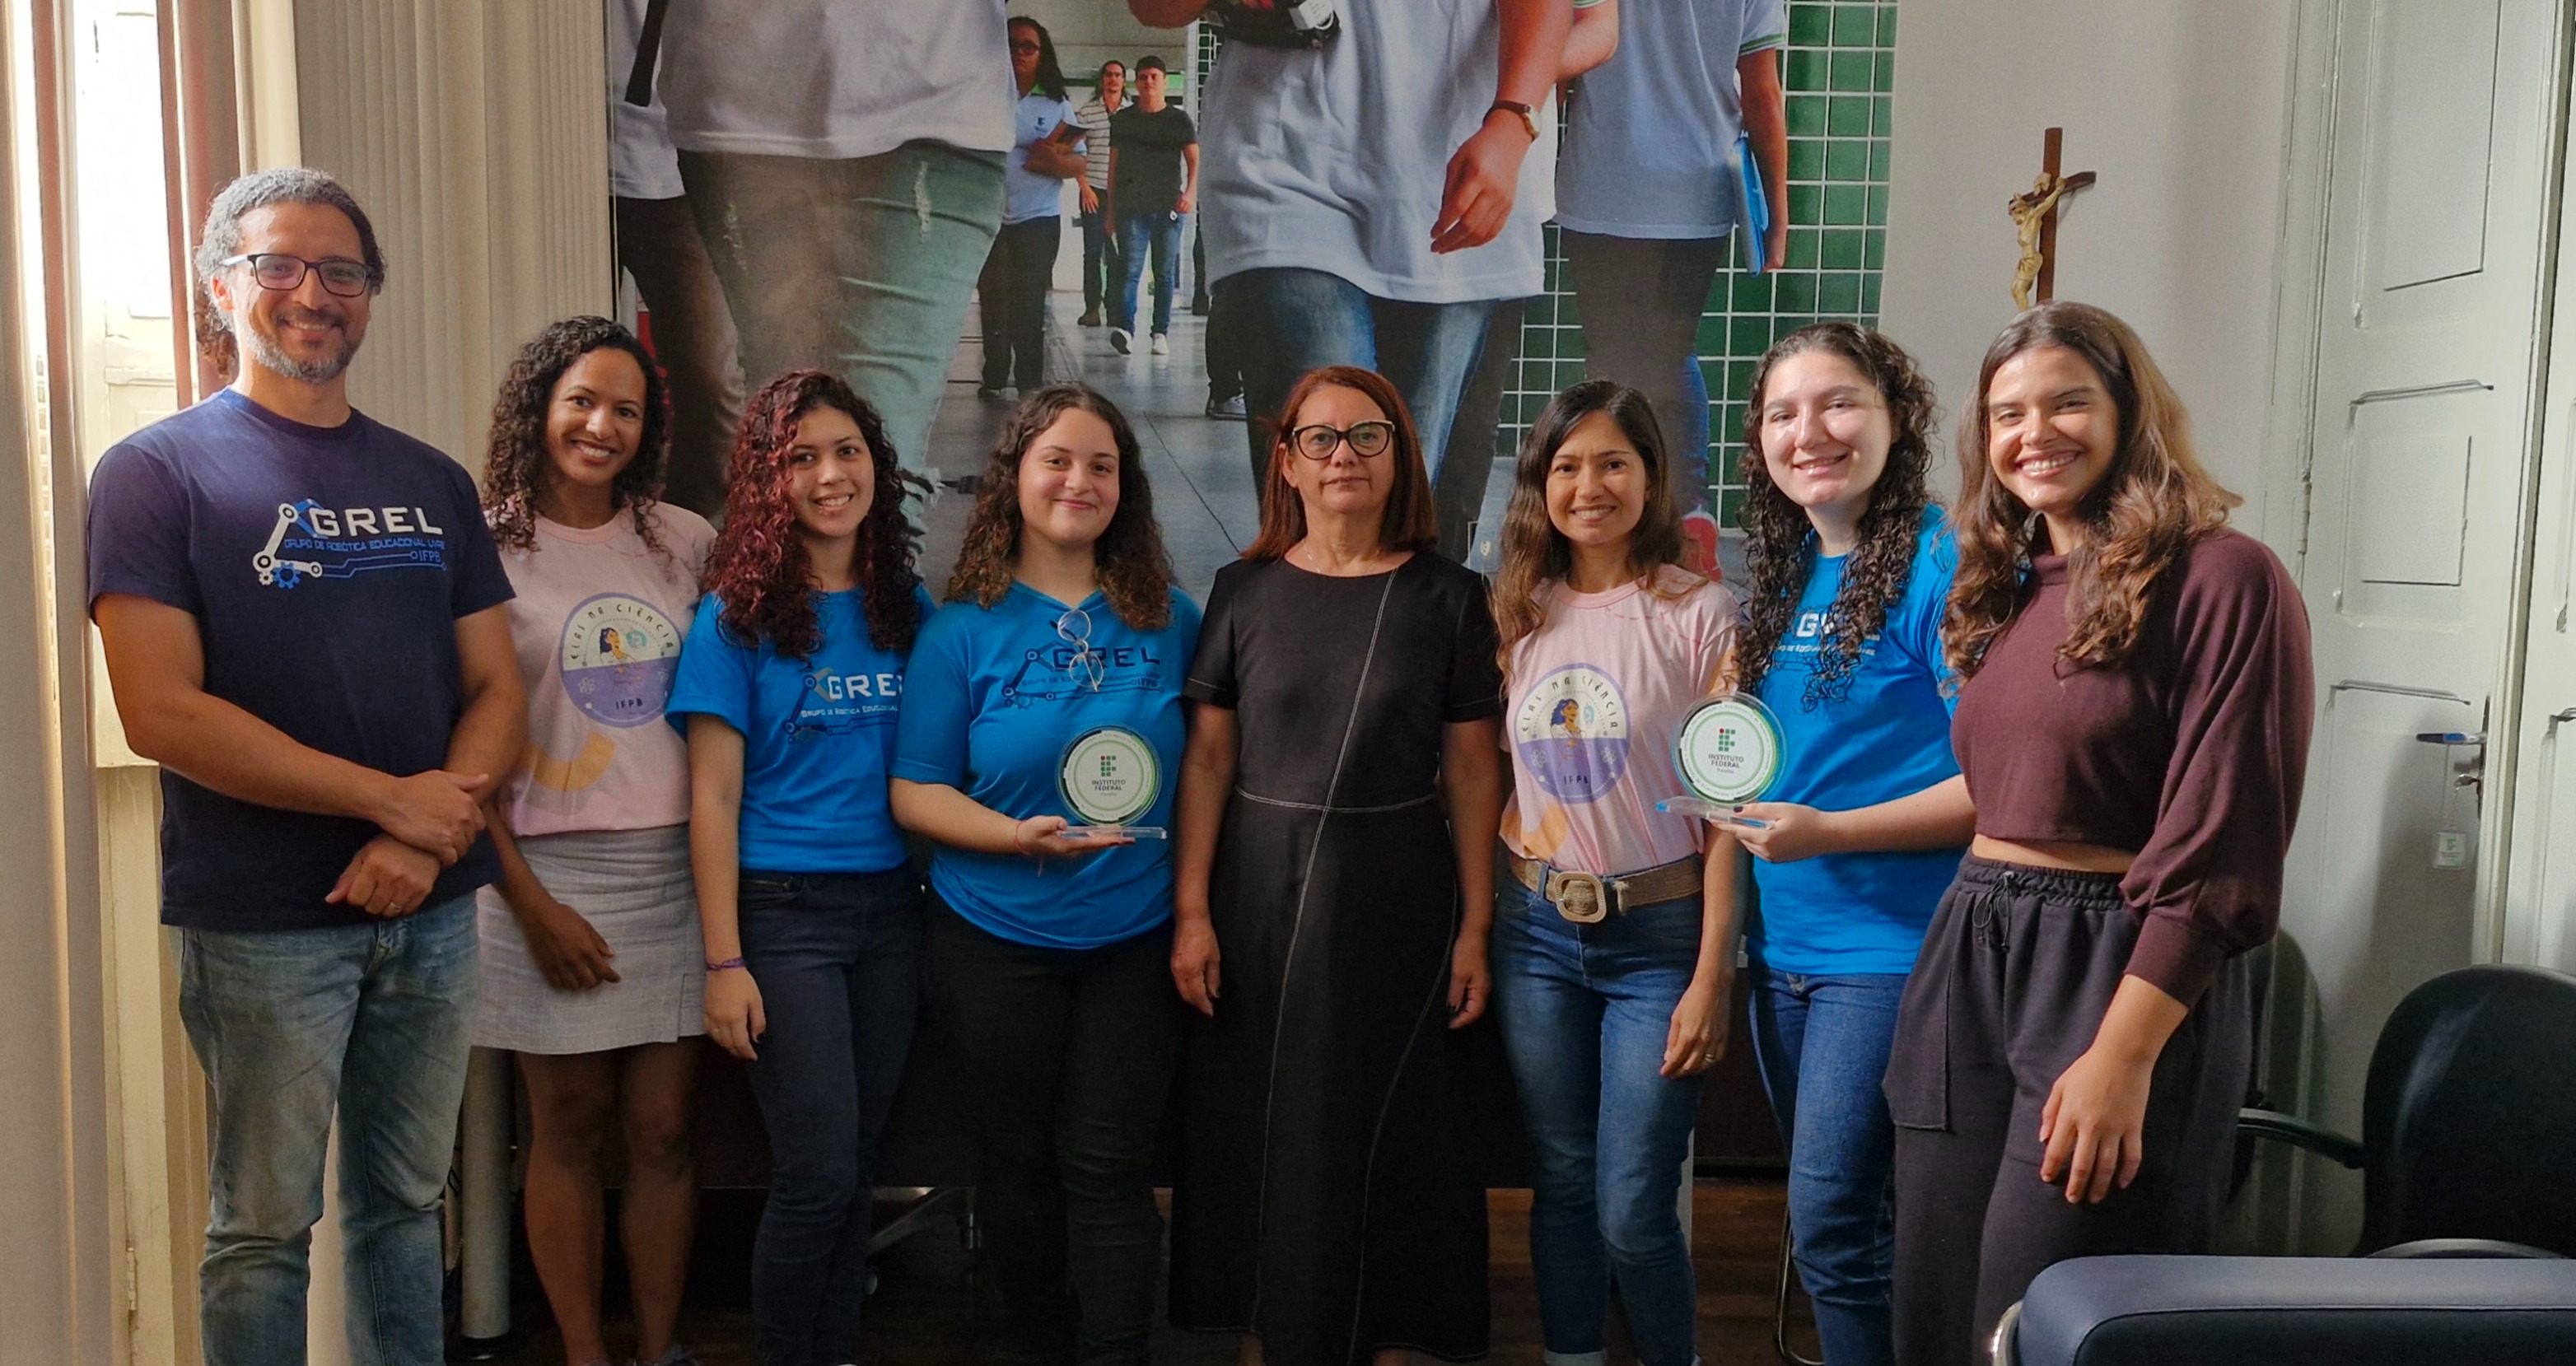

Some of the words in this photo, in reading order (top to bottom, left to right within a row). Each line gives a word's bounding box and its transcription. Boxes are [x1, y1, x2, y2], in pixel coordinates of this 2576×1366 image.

[309, 507, 443, 536] GREL
[284, 538, 313, 548] GRUPO
[418, 550, 441, 562] IFPB
[615, 697, 643, 710] IFPB
[1708, 753, 1745, 762] INSTITUTO
[1563, 775, 1588, 784] IFPB
